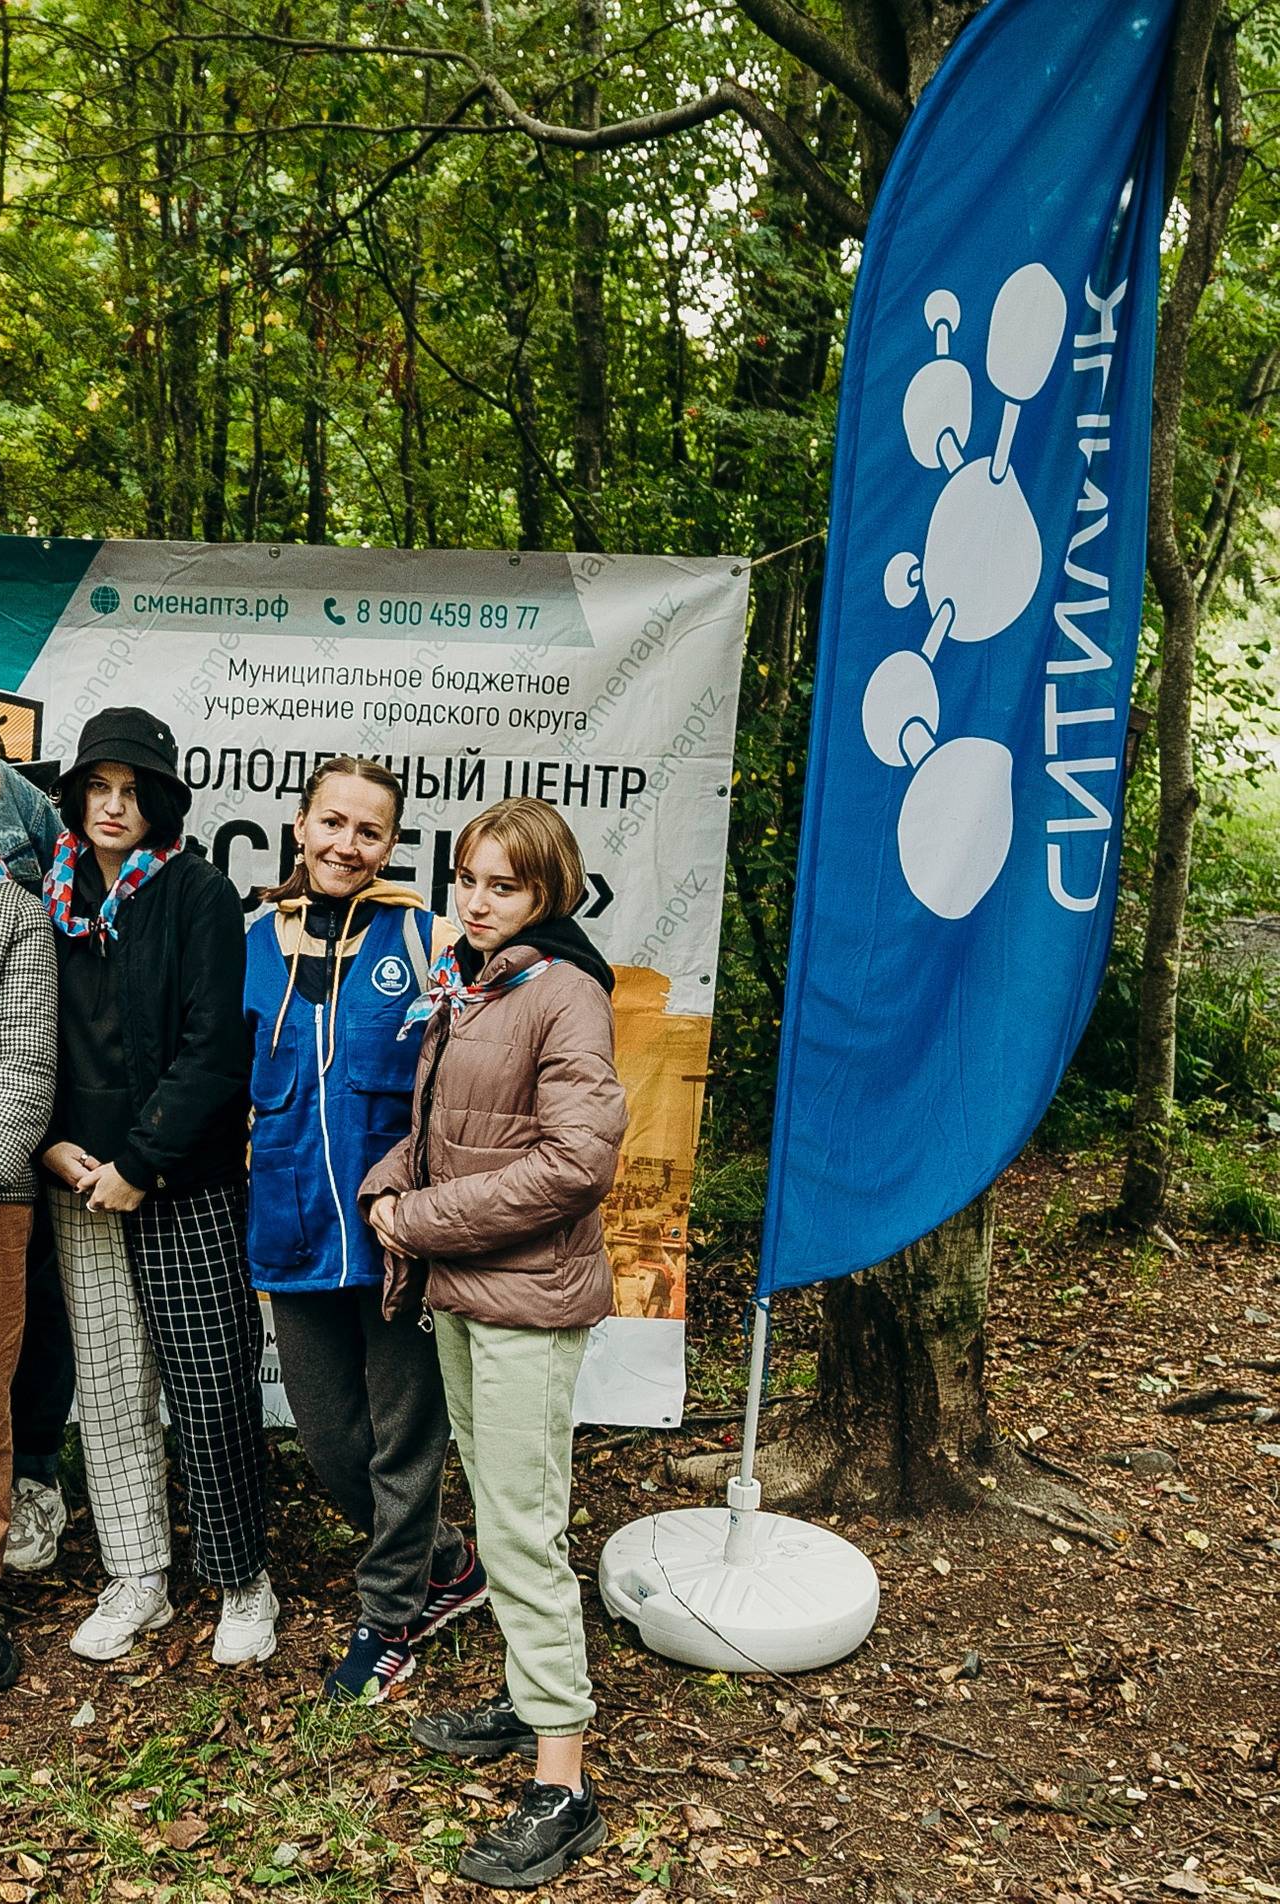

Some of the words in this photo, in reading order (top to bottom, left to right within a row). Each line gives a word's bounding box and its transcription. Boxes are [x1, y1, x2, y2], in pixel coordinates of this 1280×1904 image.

[133, 593, 289, 623] сменаптз.рф
[357, 599, 370, 623] 8
[379, 600, 422, 625] 900
[429, 602, 471, 628] 459
[479, 604, 508, 629] 89
[516, 605, 540, 630] 77
[227, 657, 423, 688] Муниципальное
[431, 664, 571, 696] бюджетное
[559, 592, 684, 763] #smenaptz
[203, 695, 354, 721] учреждение
[363, 700, 500, 728] городского
[508, 706, 588, 736] округа
[503, 759, 647, 809] ЦЕНТР
[601, 686, 726, 857] #smenaptz
